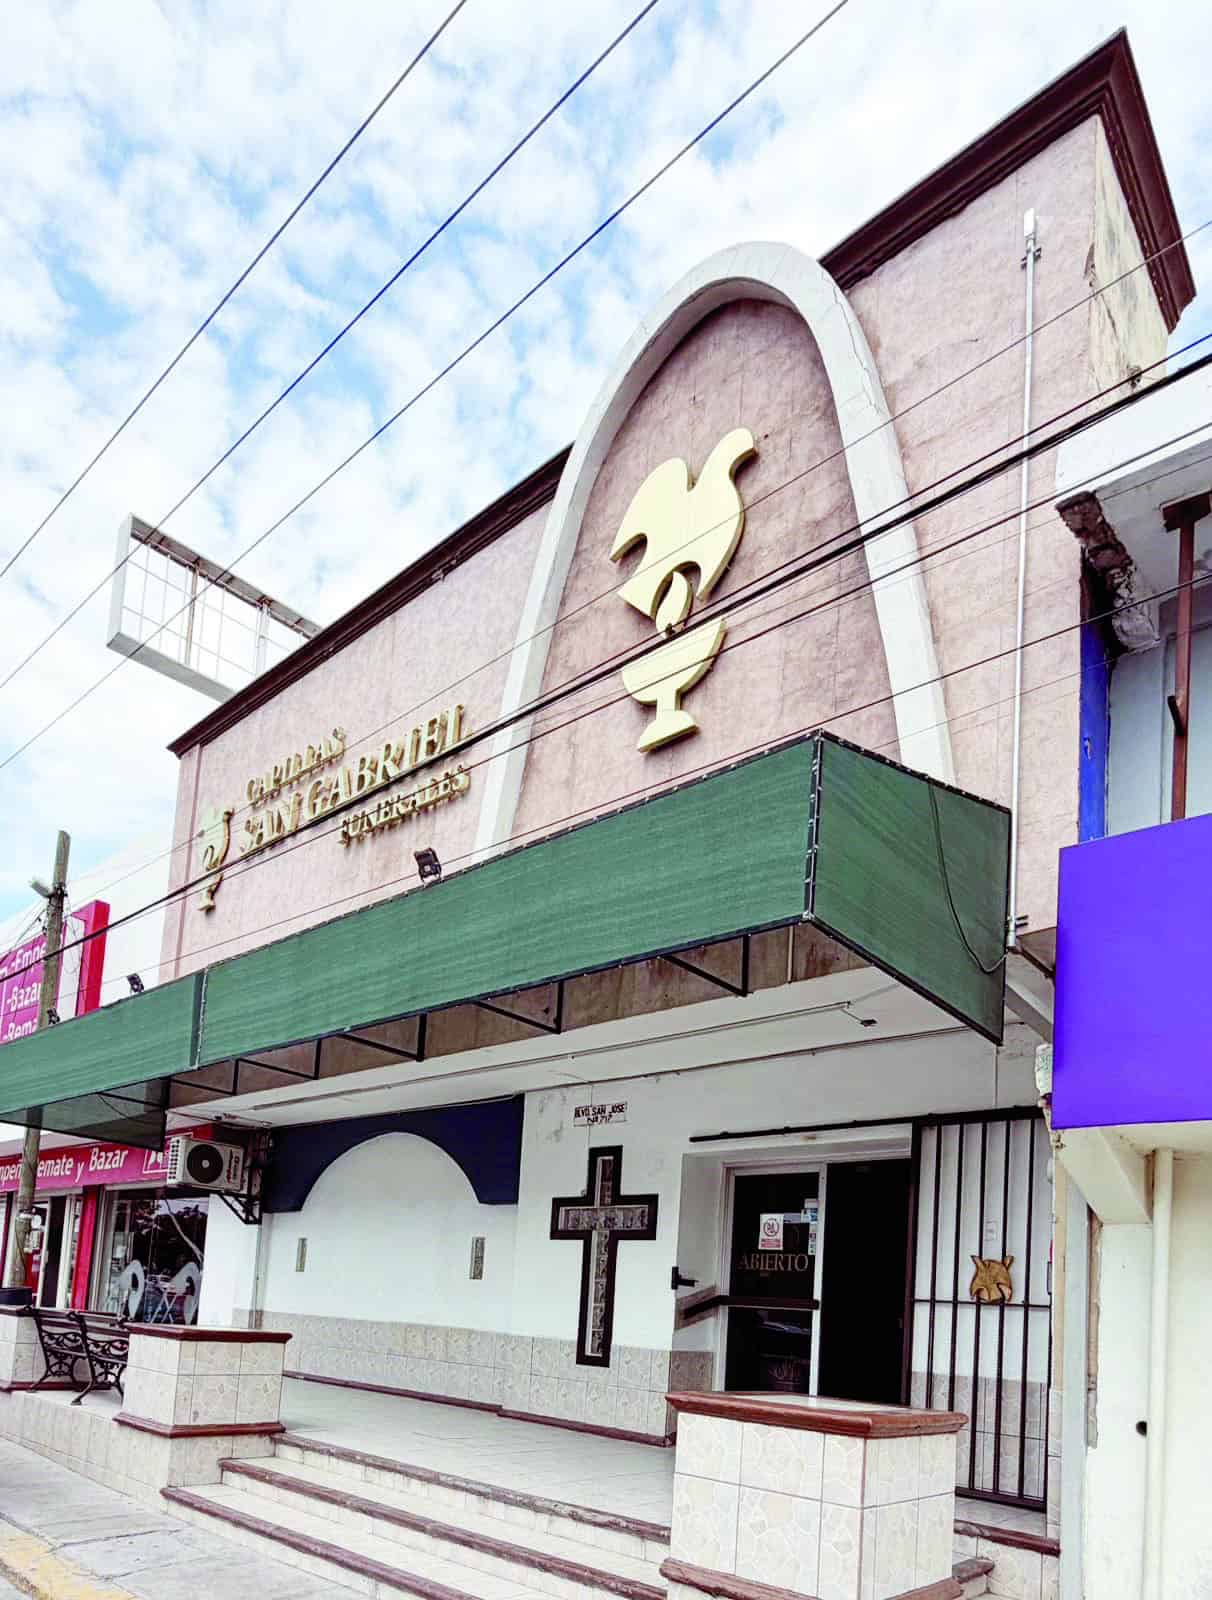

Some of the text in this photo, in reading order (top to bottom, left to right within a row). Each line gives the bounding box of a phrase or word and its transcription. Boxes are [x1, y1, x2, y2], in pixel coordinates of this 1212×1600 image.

[240, 703, 475, 855] SAN GABRIEL
[246, 726, 347, 803] CAPILLAS
[338, 765, 472, 848] FUNERALES
[591, 1105, 606, 1116] SAN
[608, 1103, 625, 1114] JOSE
[36, 1154, 74, 1178] emate
[75, 1161, 84, 1184] y
[88, 1147, 129, 1172] Bazar
[738, 1253, 809, 1272] ABIERTO
